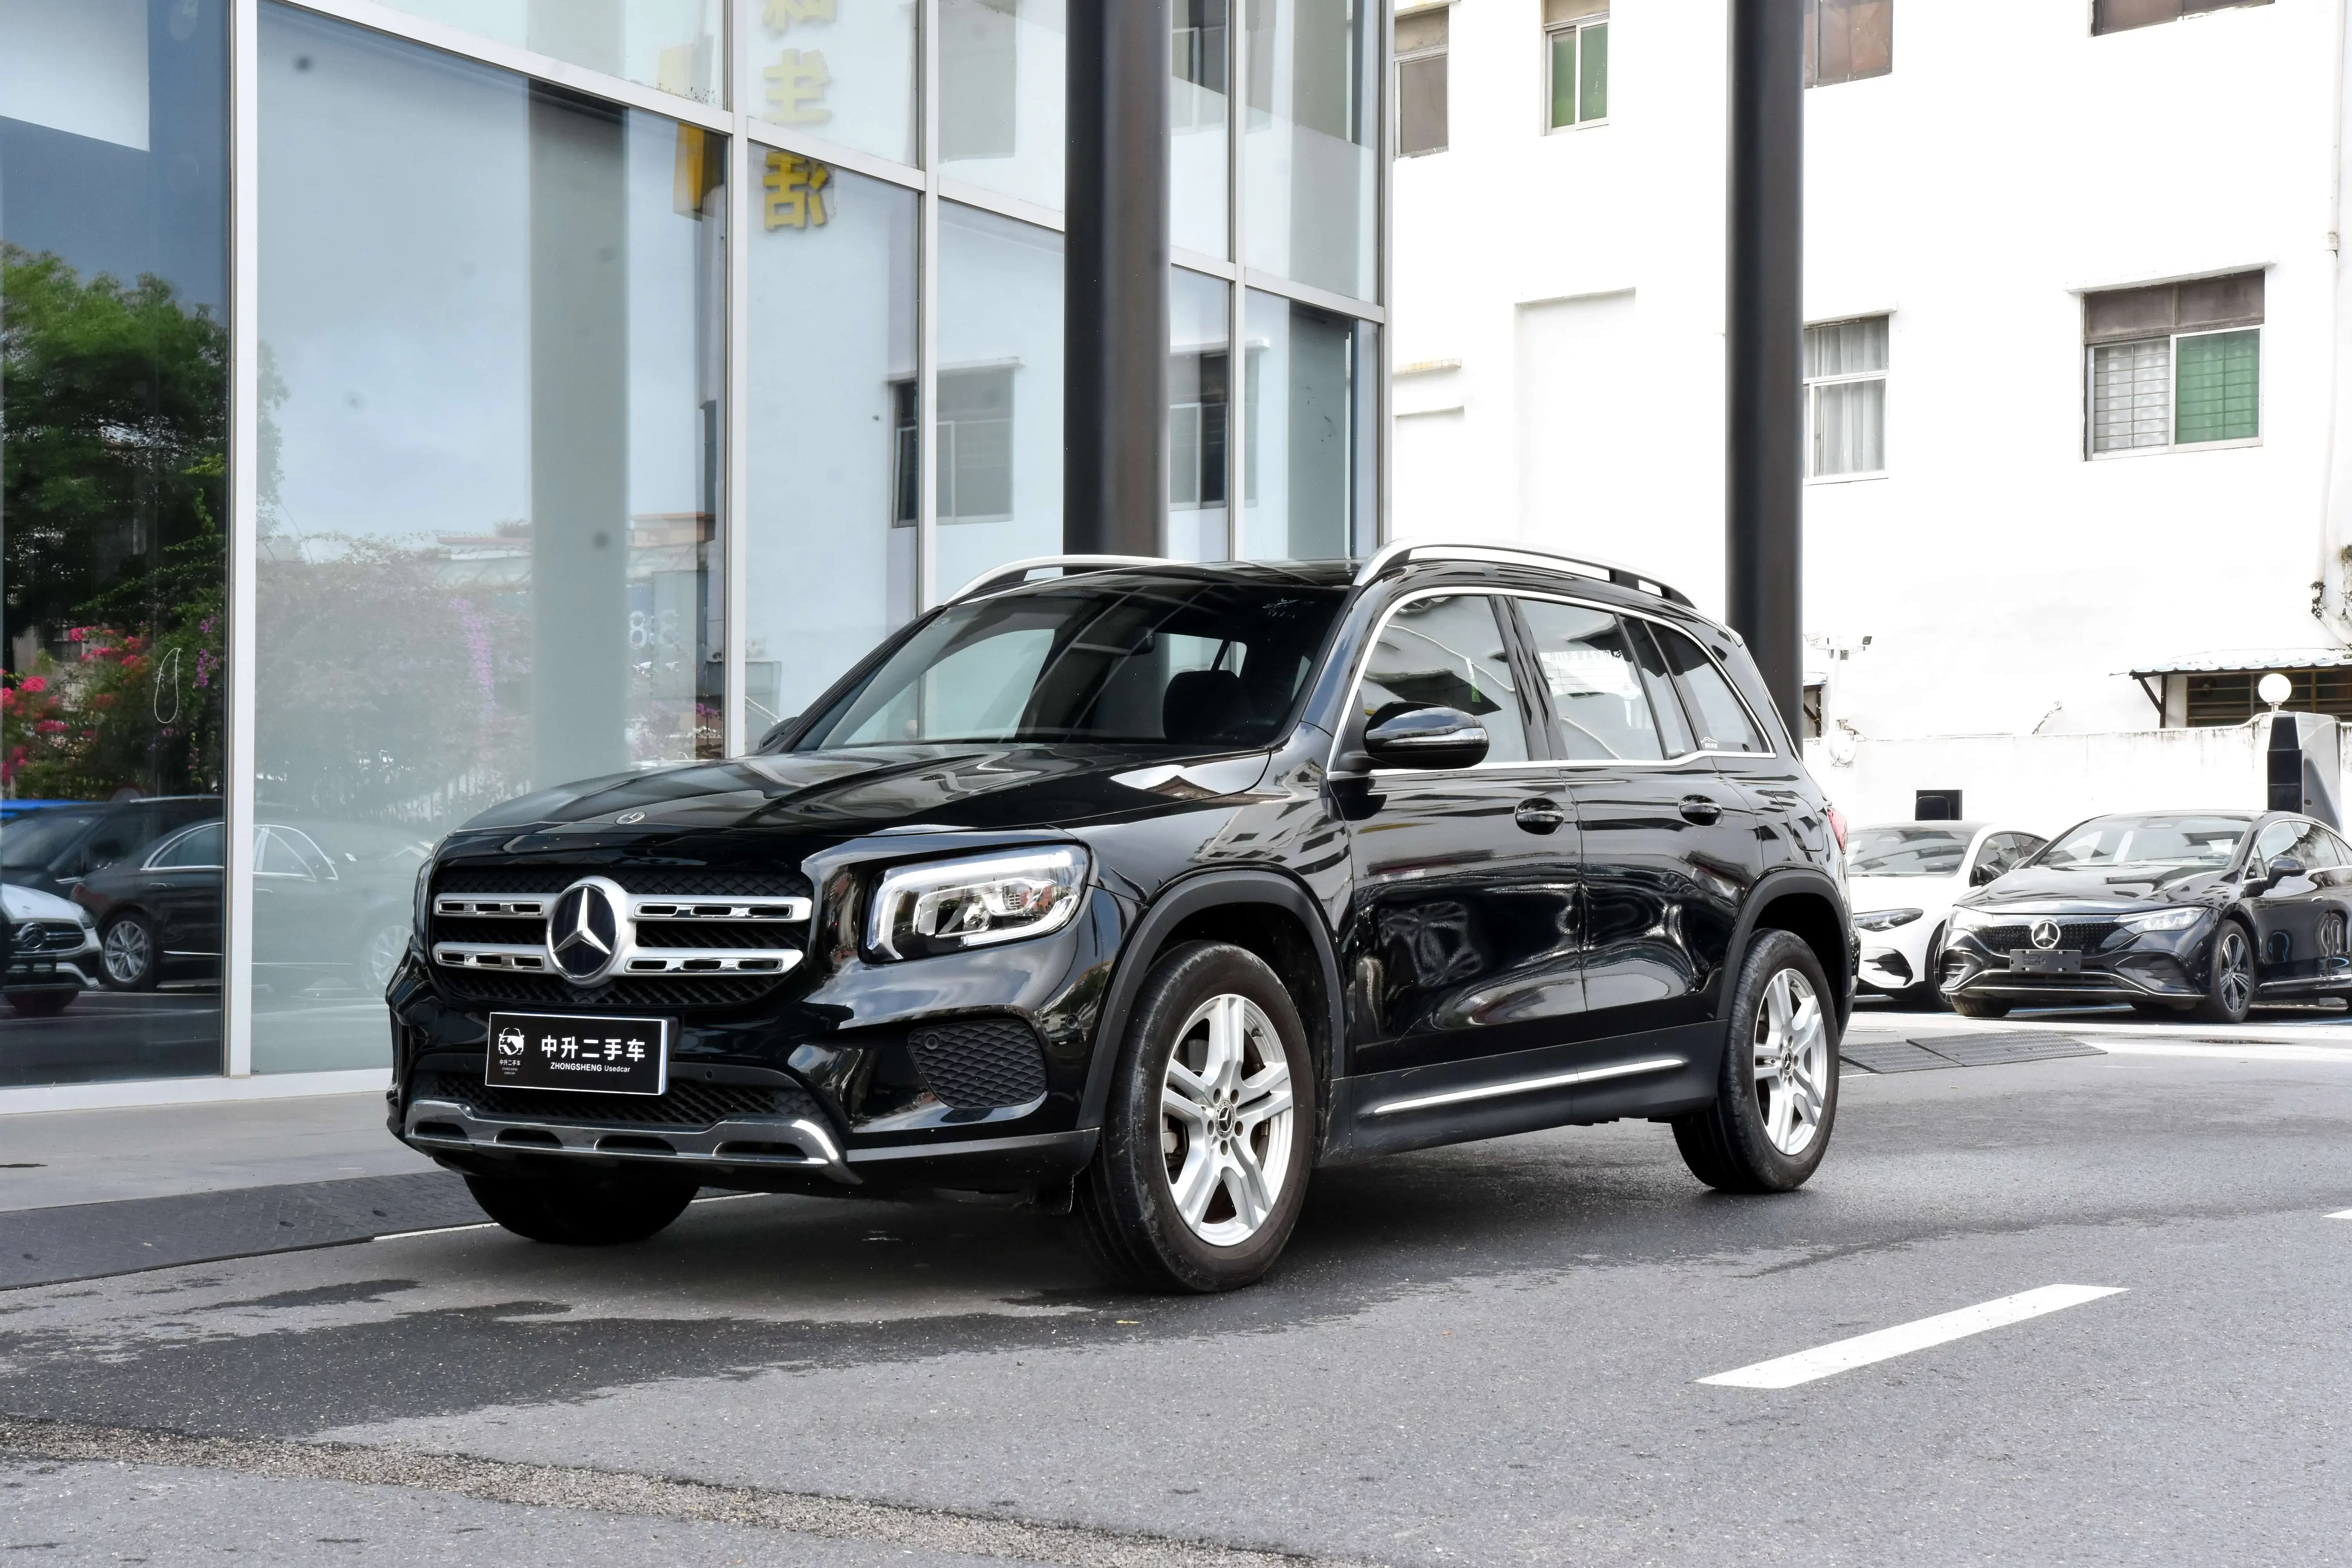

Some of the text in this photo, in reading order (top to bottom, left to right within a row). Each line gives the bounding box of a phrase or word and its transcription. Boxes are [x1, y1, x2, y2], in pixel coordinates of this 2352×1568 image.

[541, 1035, 645, 1062] 中升二手车
[550, 1062, 602, 1072] ZHONGSHENG
